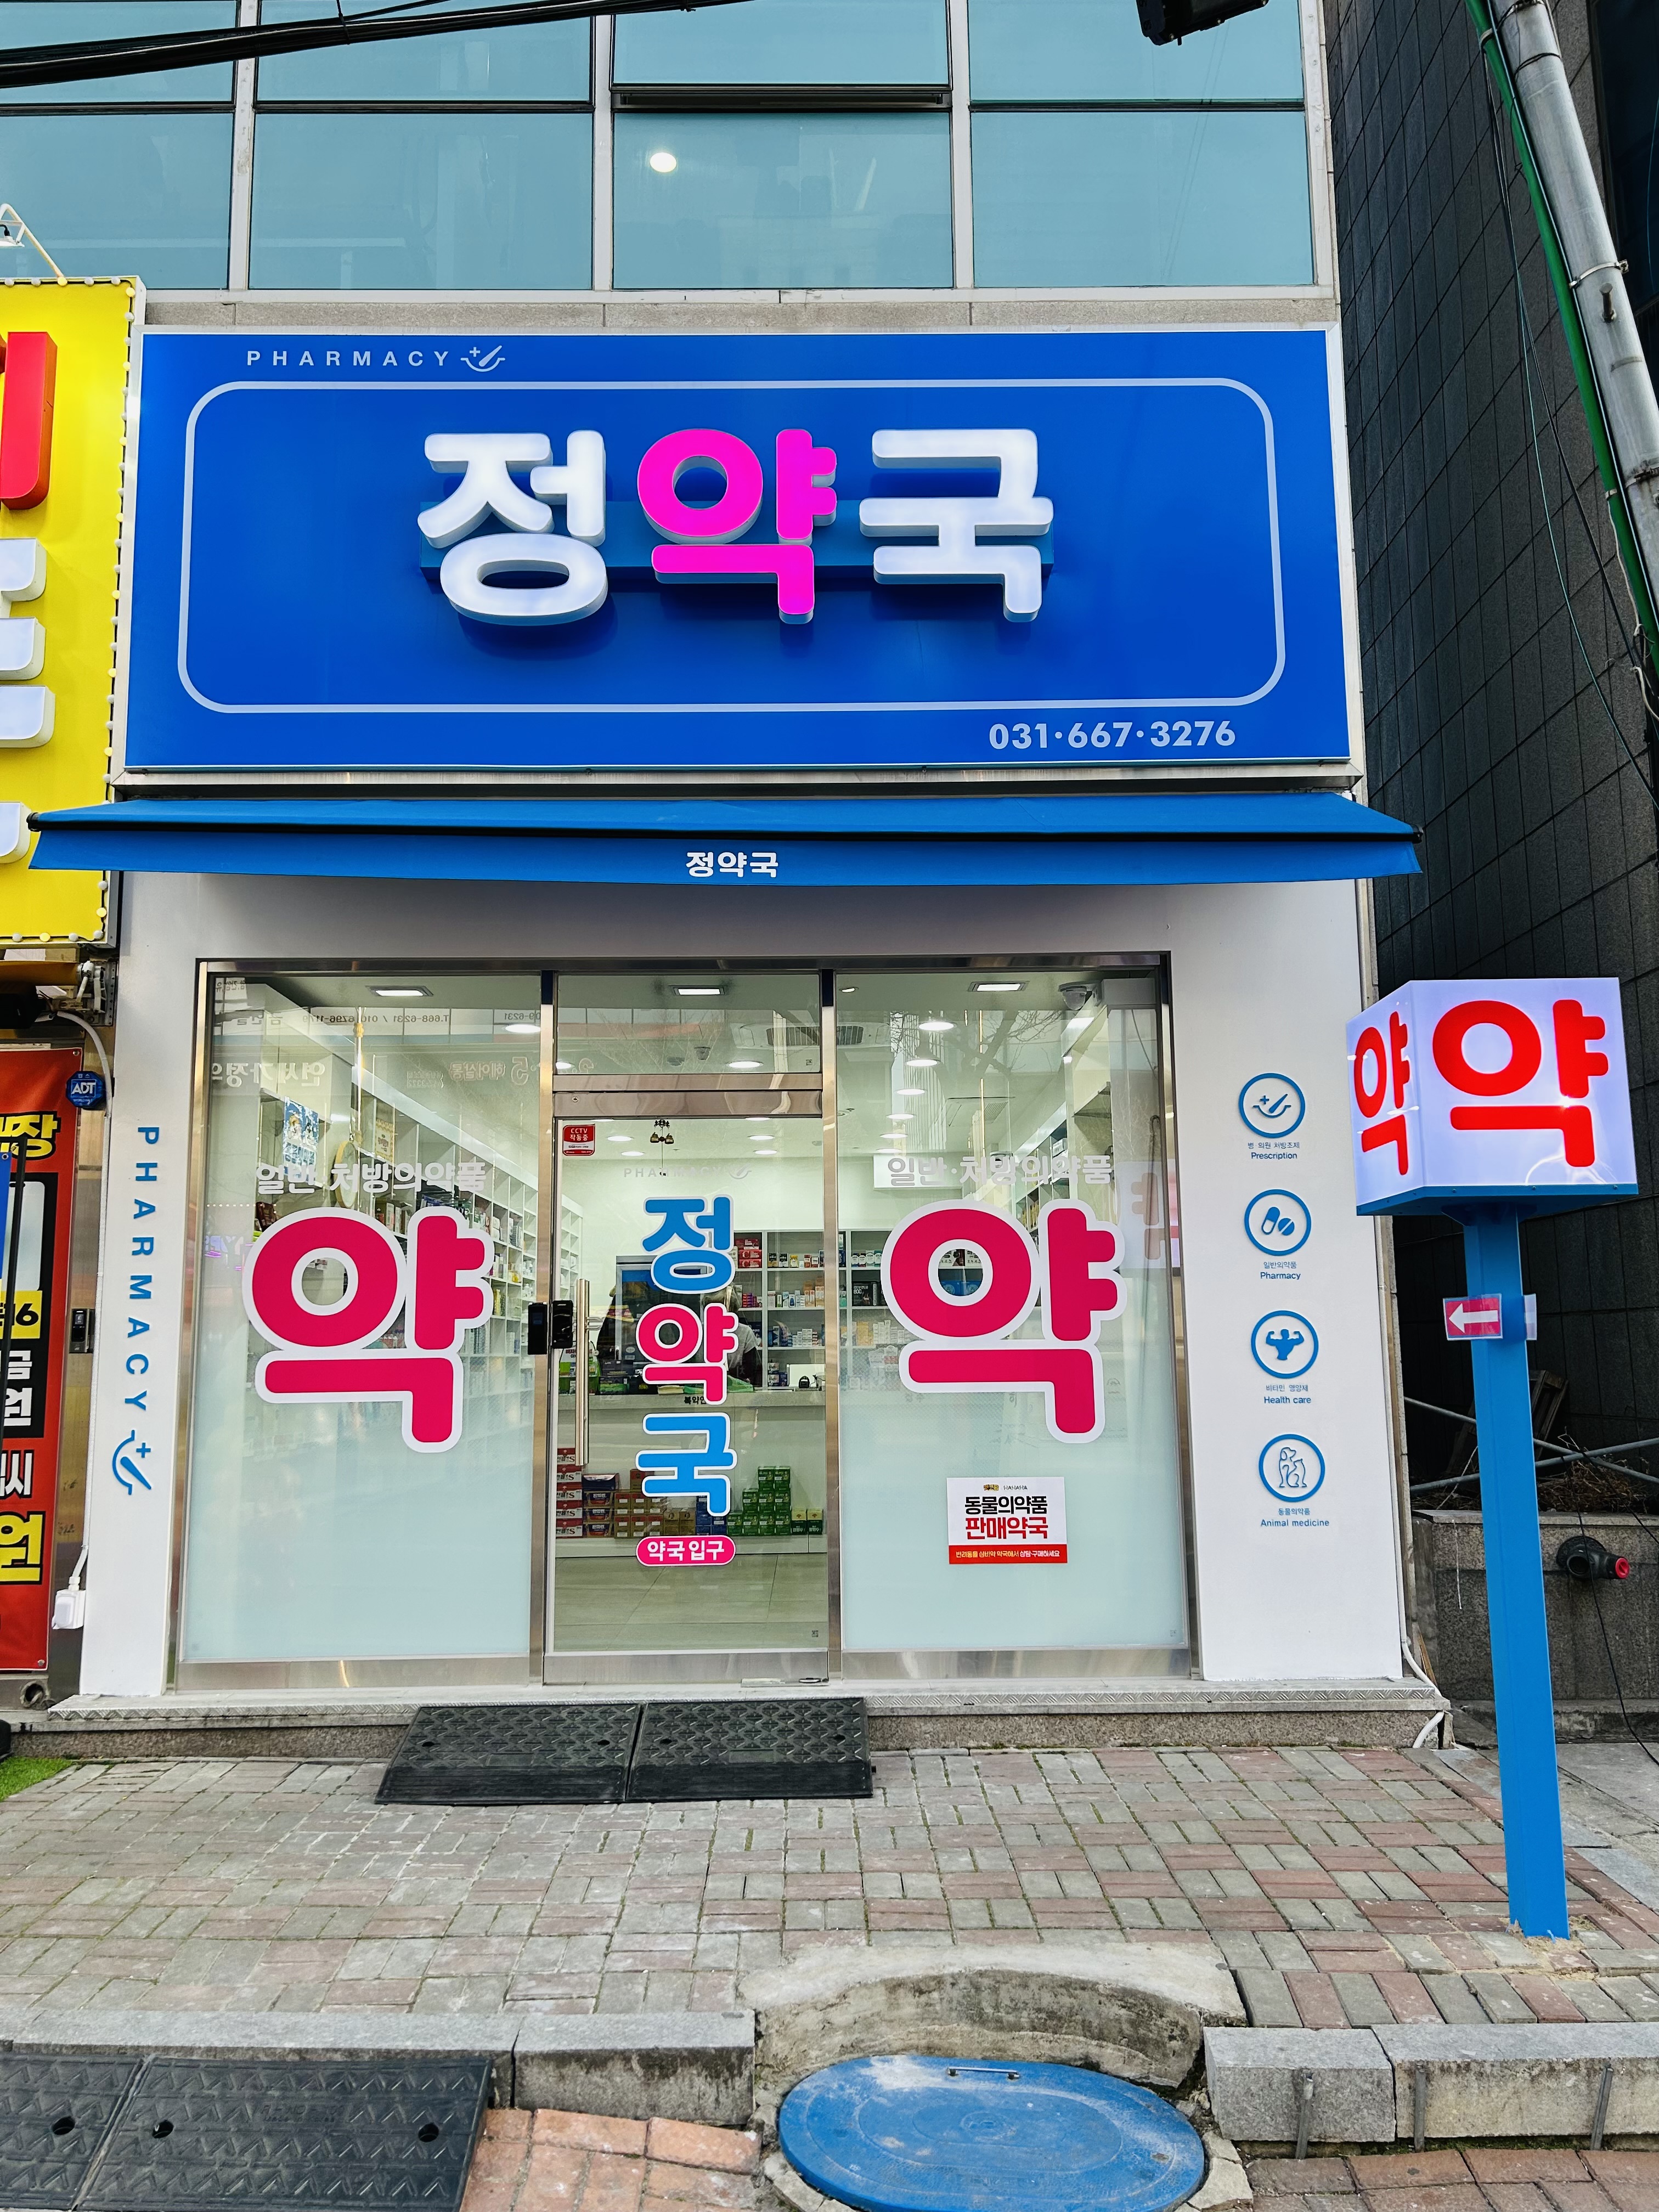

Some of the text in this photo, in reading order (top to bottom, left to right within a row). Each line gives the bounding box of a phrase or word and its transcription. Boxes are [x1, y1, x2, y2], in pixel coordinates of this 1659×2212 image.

[246, 350, 450, 366] PHARMACY
[417, 428, 1053, 625] 정약국
[686, 851, 778, 878] 정약국
[71, 1082, 96, 1095] ADT
[1353, 1011, 1411, 1176] 약
[1432, 999, 1609, 1167] 약
[0, 1114, 58, 1158] 장
[1251, 1152, 1297, 1160] Prescription
[124, 1126, 160, 1412] PHARMACY
[1260, 1272, 1301, 1280] Pharmacy
[1263, 1261, 1297, 1269] 일반의약품
[244, 1208, 492, 1451] 약
[883, 1200, 1126, 1442] 약
[1263, 1396, 1290, 1404] Health
[964, 1496, 1048, 1515] 동물의약품
[1278, 1507, 1311, 1516] 동물의약품
[965, 1517, 1048, 1539] 판매약국
[1261, 1518, 1330, 1527] Animal medicine
[647, 1540, 726, 1562] 약국 입구
